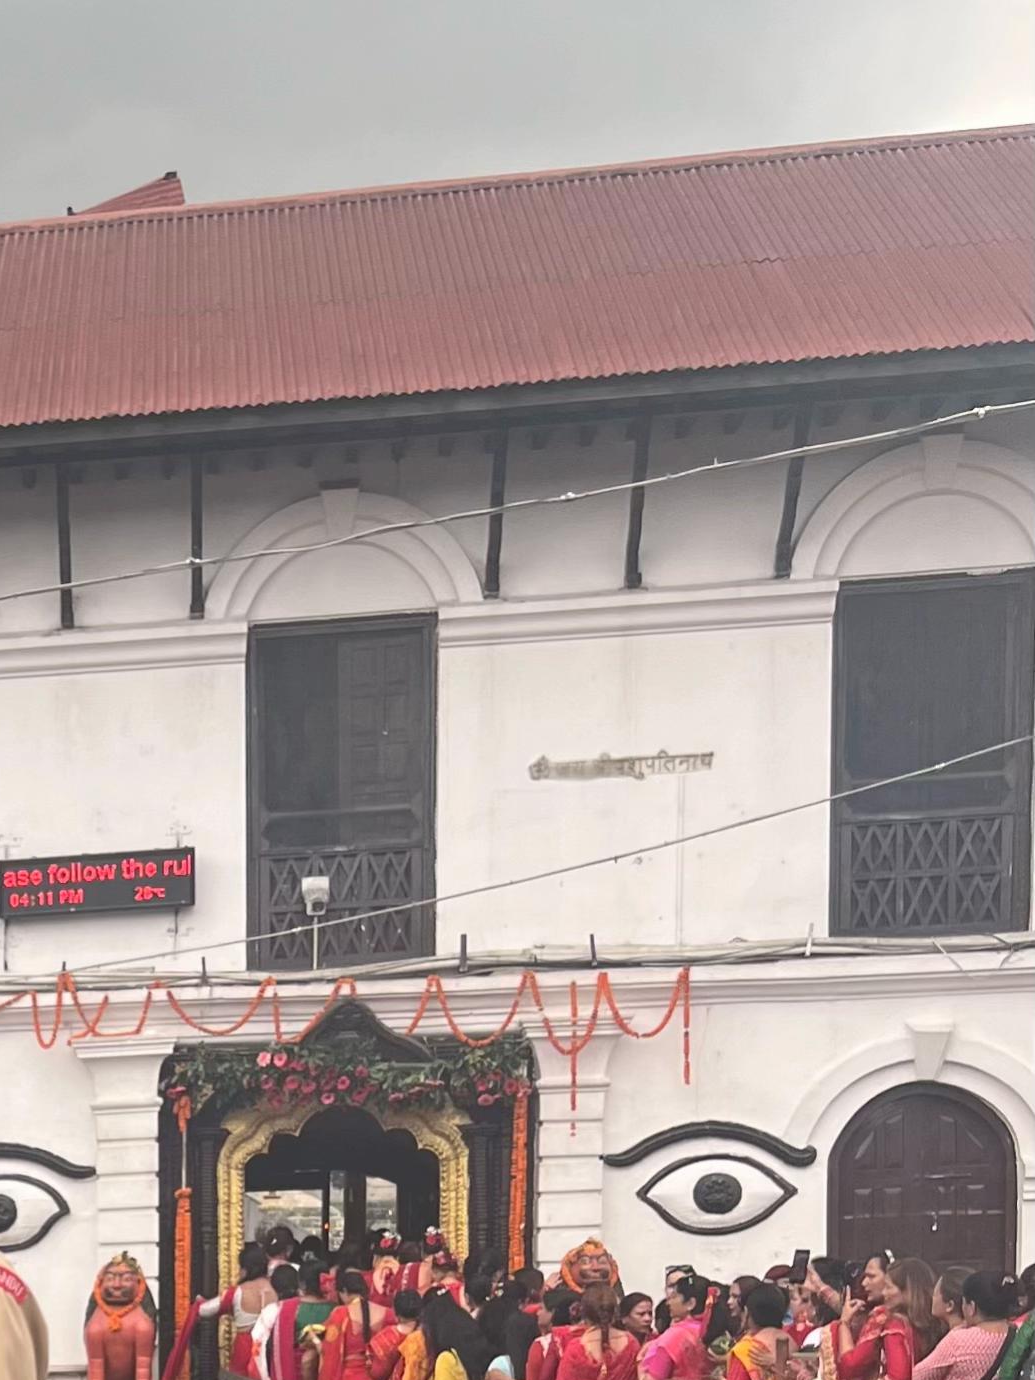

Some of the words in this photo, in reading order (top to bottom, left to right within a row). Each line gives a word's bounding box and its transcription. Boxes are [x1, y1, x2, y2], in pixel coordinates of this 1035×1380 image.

[3, 869, 43, 888] ase
[48, 861, 117, 885] follow
[121, 858, 157, 880] the
[163, 854, 192, 876] rul
[9, 891, 54, 908] 04:11
[58, 888, 84, 904] PM
